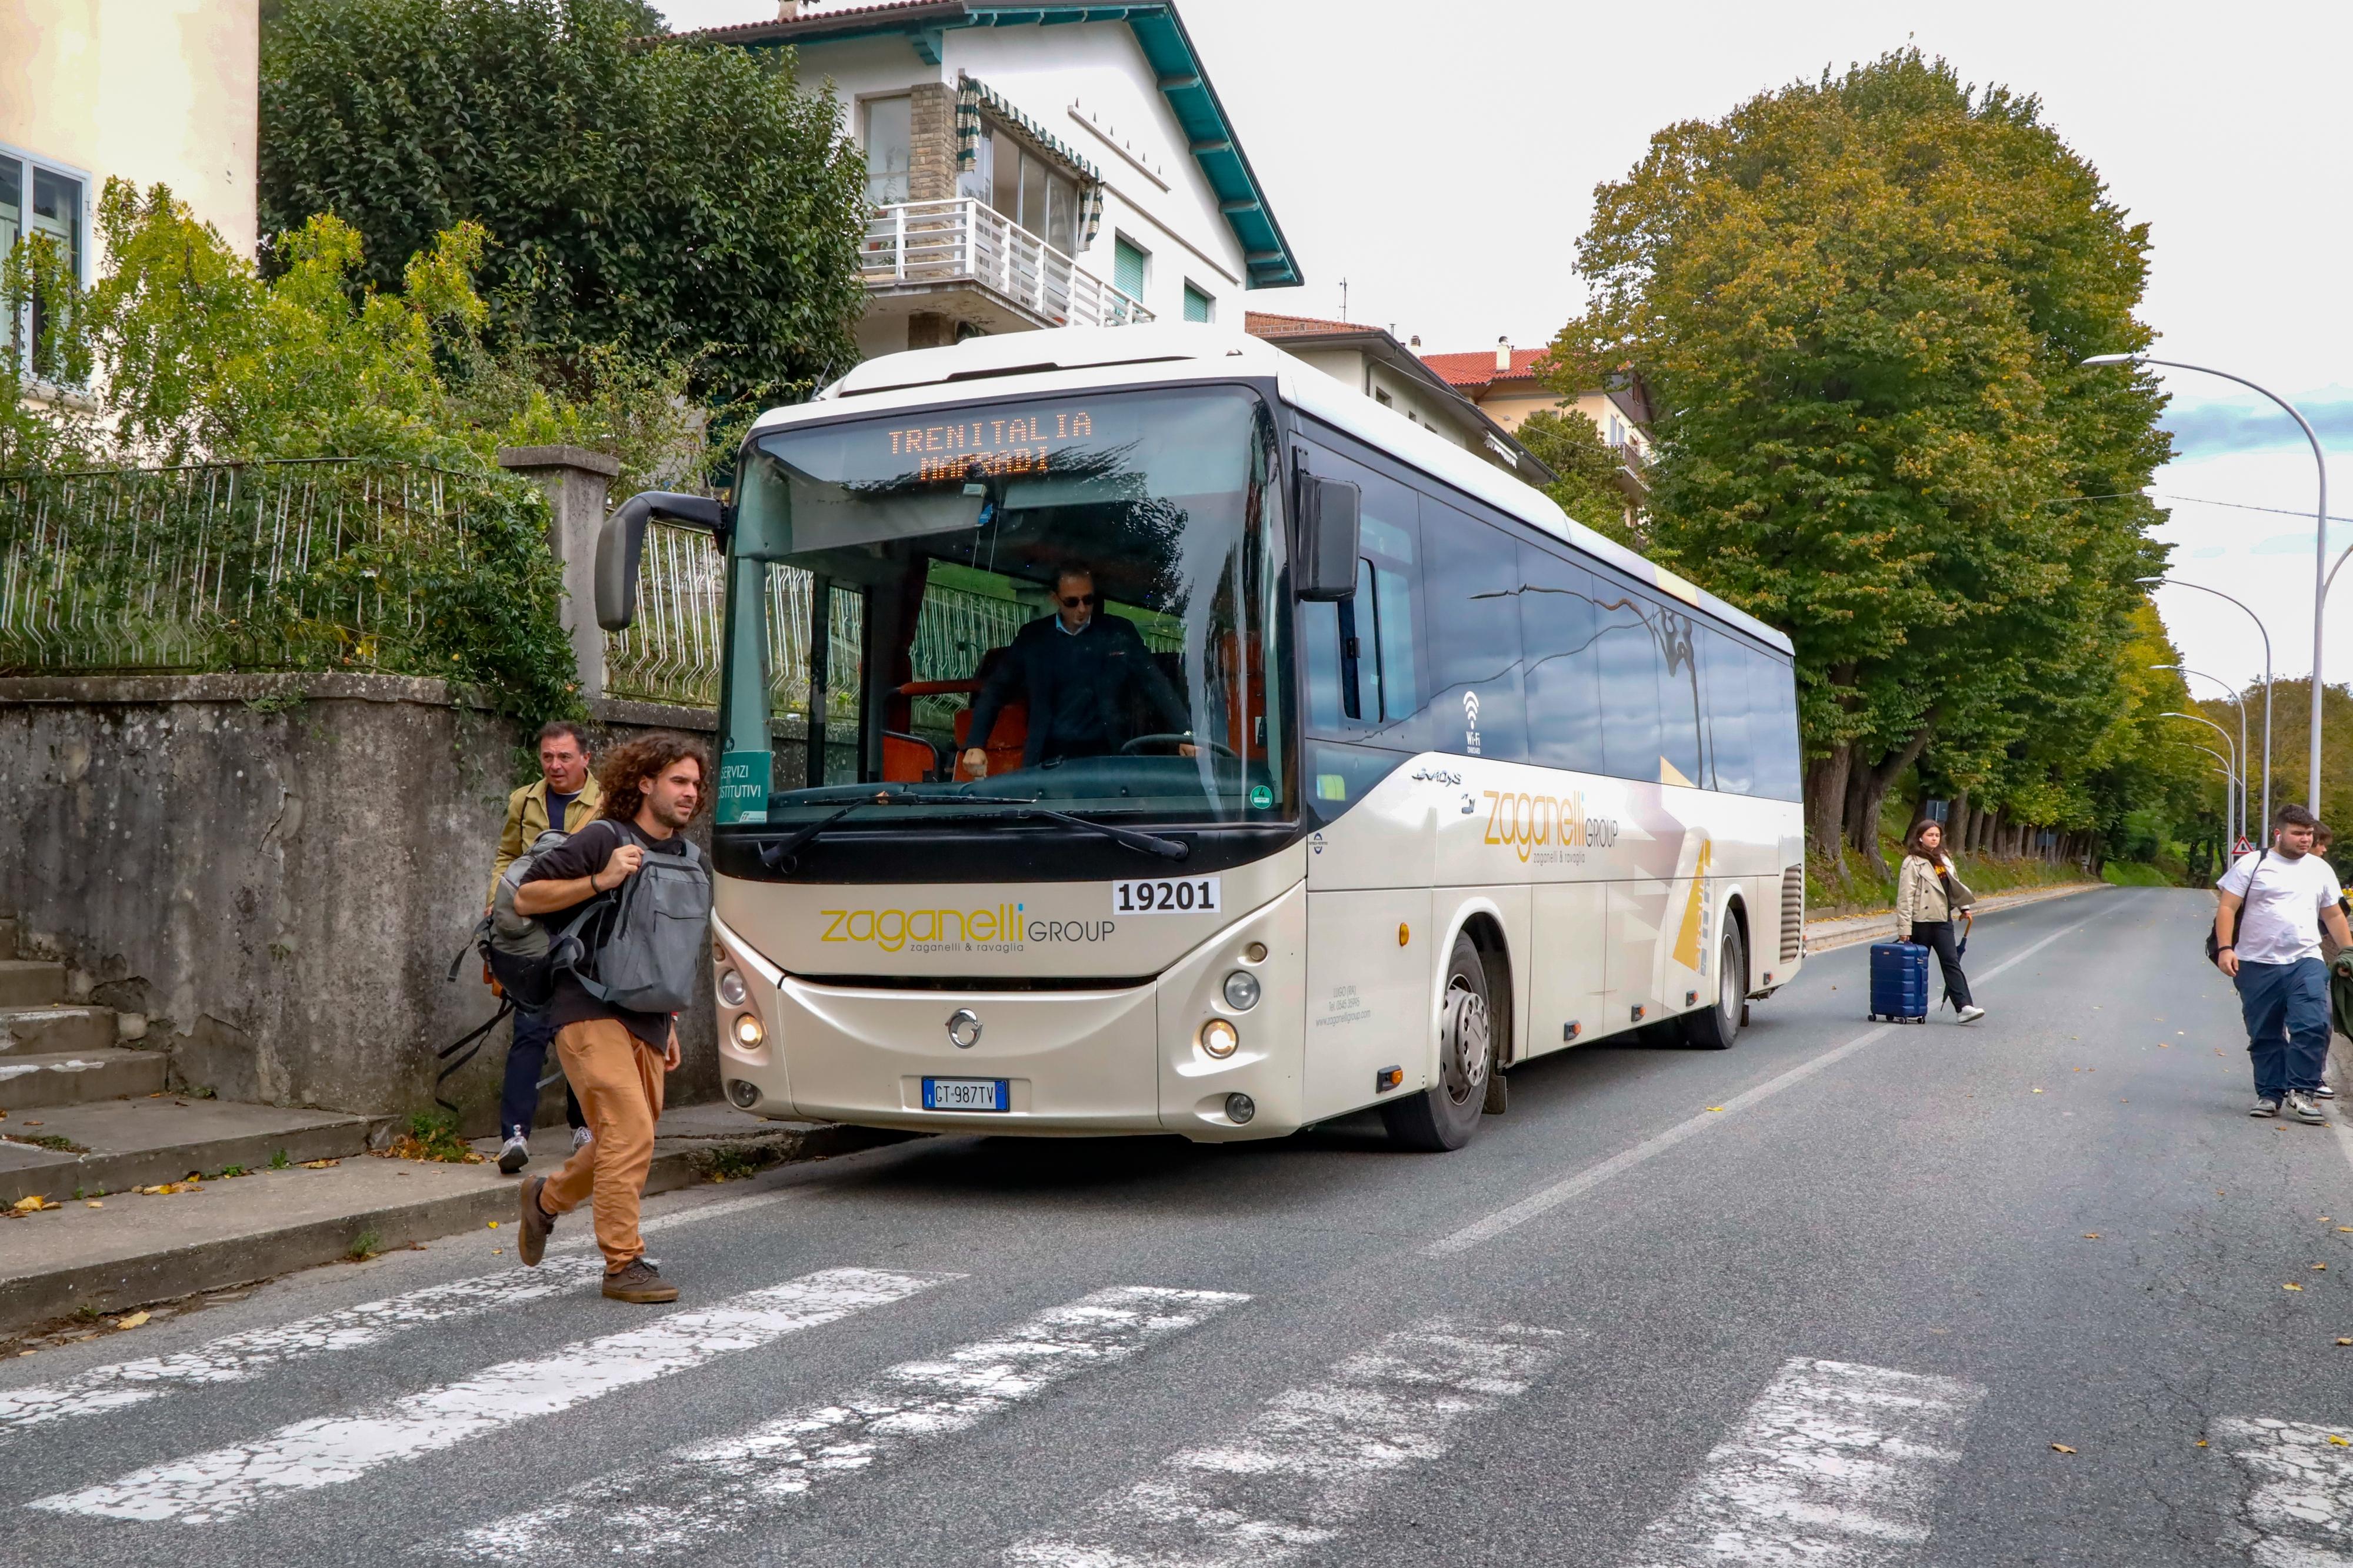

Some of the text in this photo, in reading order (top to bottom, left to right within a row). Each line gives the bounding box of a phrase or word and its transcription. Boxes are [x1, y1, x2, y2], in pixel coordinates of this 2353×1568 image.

[889, 412, 1092, 455] TRENITALIA
[1466, 731, 1481, 746] Wi-Fi
[721, 765, 749, 779] SERVIZI
[1484, 790, 1585, 863] zaganelli
[1585, 818, 1618, 848] GROUP
[1534, 850, 1558, 866] zaganelli
[1565, 851, 1585, 866] ravaglia
[1119, 882, 1214, 910] 19201
[821, 903, 1115, 952] zaganelli GROUP
[910, 943, 1024, 953] zaganelli & ravaglia
